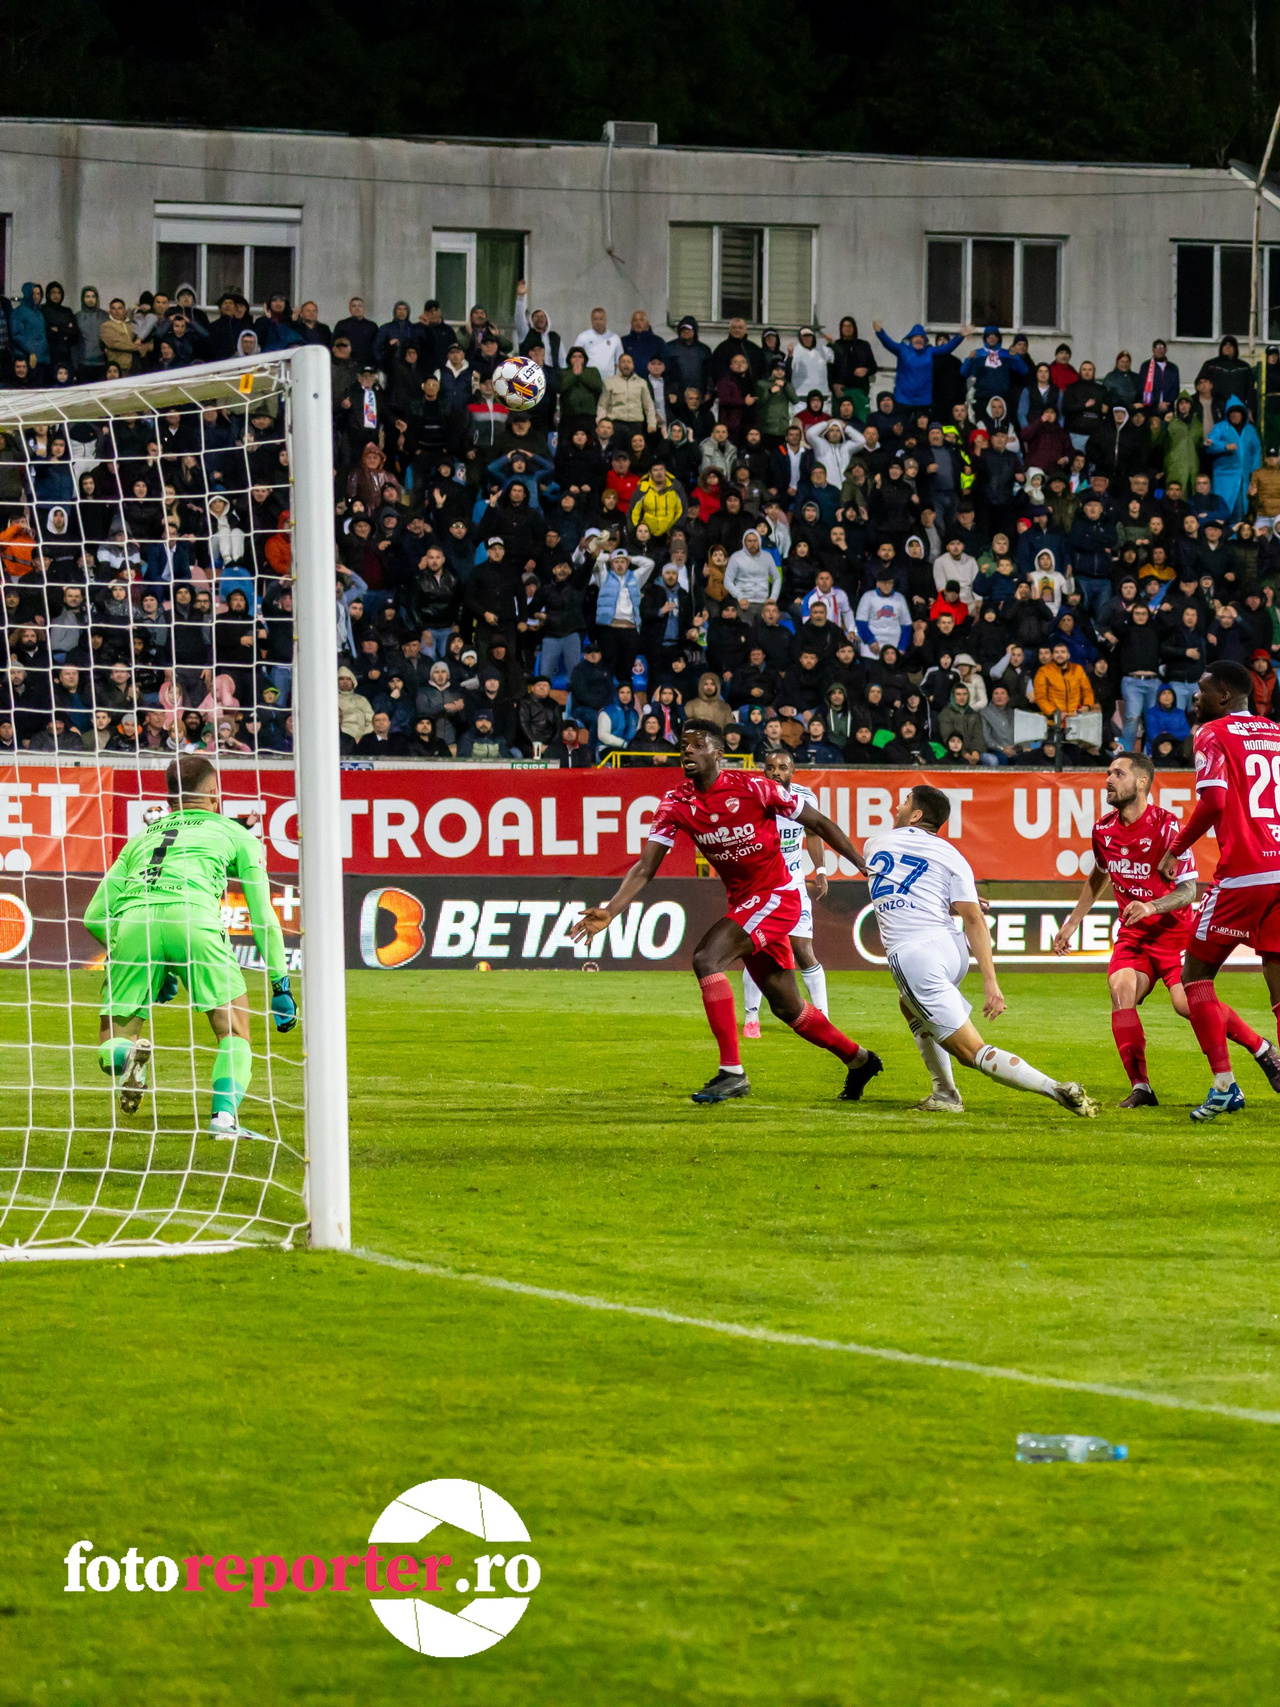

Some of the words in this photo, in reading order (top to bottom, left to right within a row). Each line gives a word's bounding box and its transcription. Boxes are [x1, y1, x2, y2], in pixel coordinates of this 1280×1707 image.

[694, 823, 755, 845] WIN2.RO
[869, 850, 930, 900] 27
[429, 899, 687, 960] BETANO
